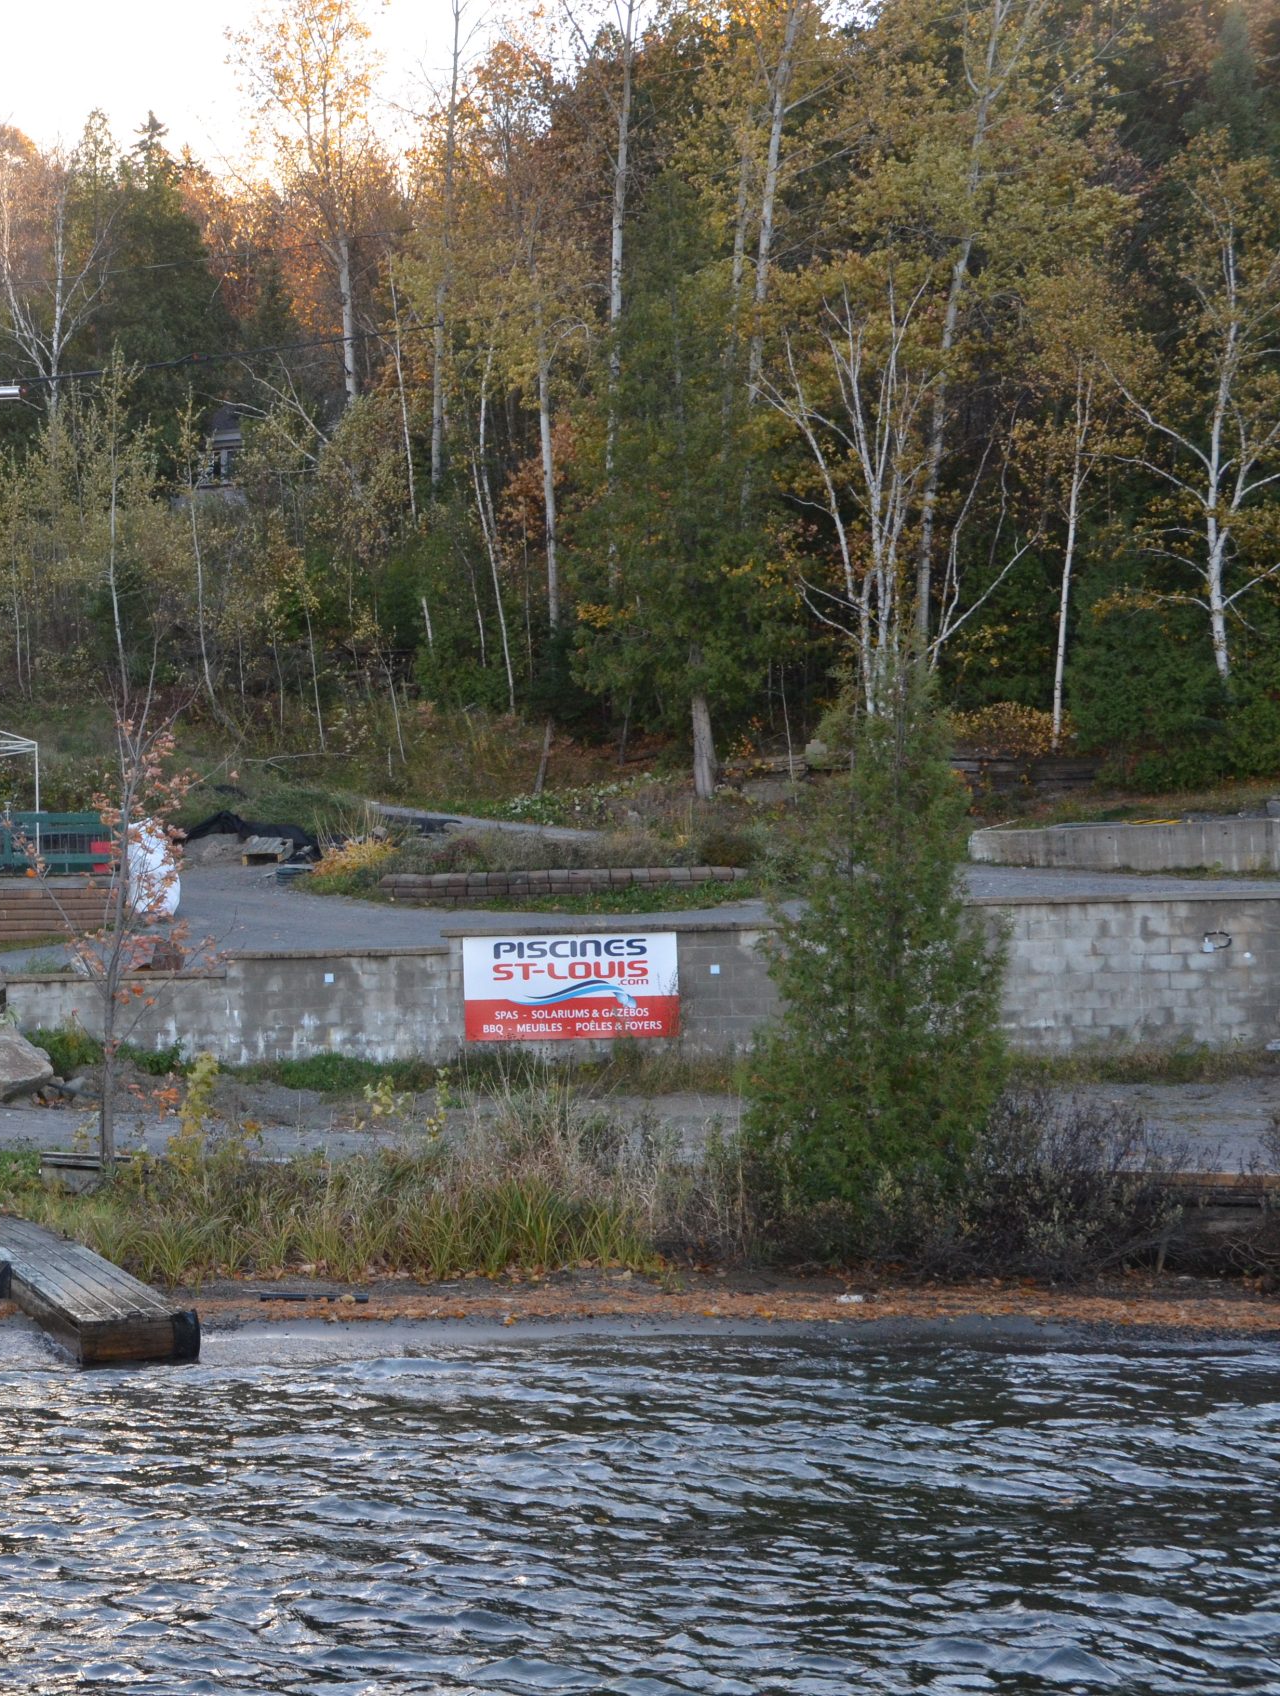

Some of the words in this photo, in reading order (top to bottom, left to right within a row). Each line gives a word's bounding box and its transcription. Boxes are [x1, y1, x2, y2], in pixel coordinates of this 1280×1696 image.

[493, 938, 647, 960] PISCINES
[492, 960, 648, 981] ST-LOUIS
[495, 1010, 518, 1020] SPAS
[531, 1009, 590, 1020] SOLARIUMS
[591, 1008, 600, 1018] &
[482, 1024, 504, 1035] BBQ
[516, 1022, 563, 1033] MEUBLES
[575, 1020, 613, 1031] POÊLES
[624, 1020, 663, 1031] FOYERS
